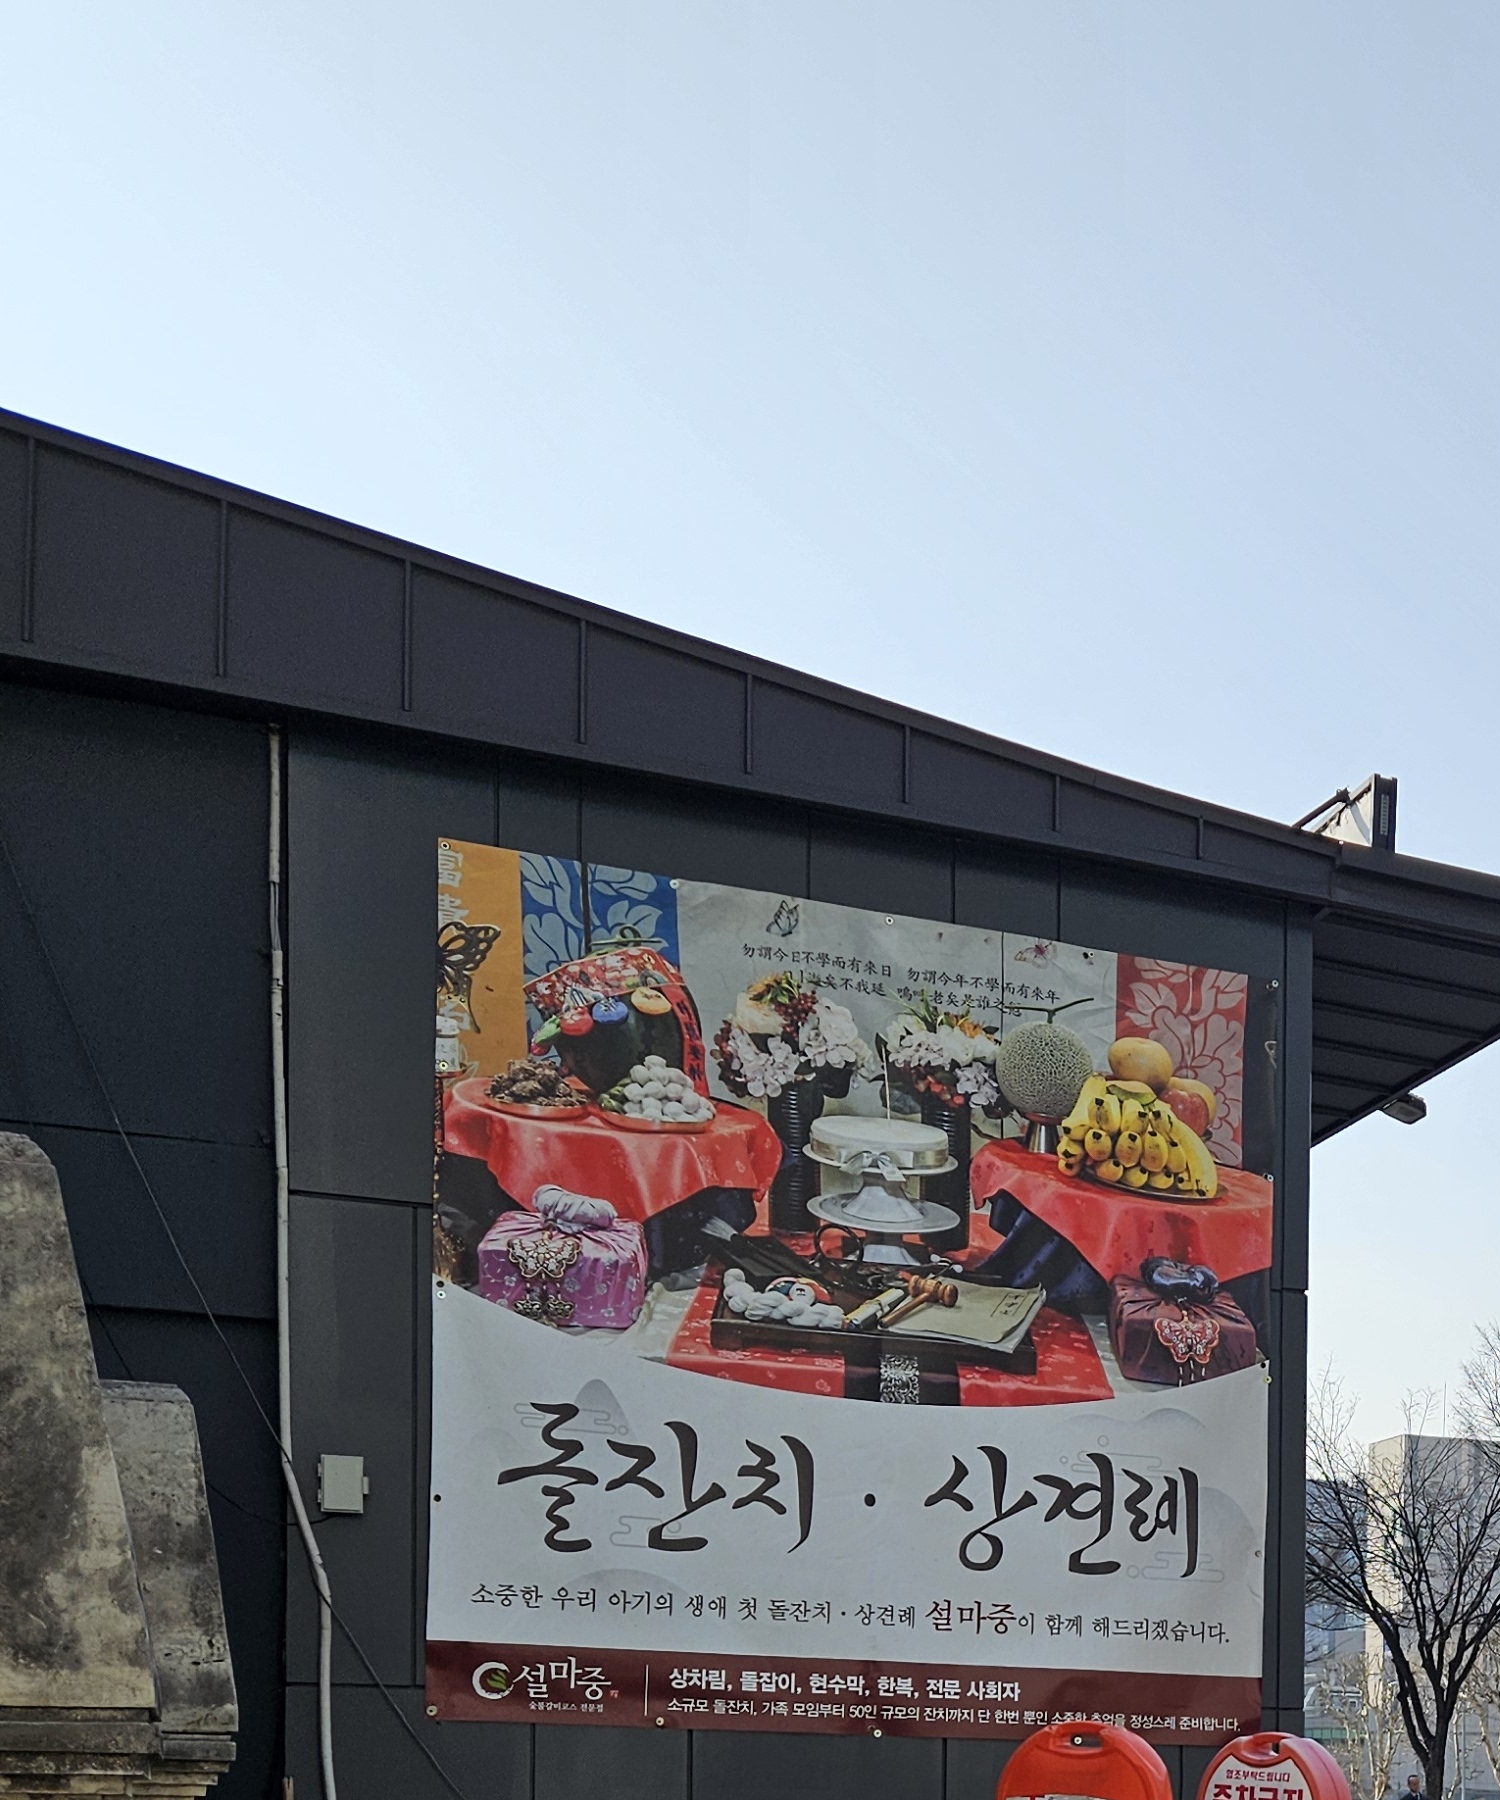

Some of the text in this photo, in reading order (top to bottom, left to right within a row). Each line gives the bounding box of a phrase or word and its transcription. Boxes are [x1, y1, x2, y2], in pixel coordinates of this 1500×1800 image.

[498, 1403, 1198, 1577] 돌잔치 상견례
[472, 1584, 1229, 1643] 소중한 우리 아기의 생애 첫 돌잔치 상견례 설마중이 함께 해드리겠습니다.
[514, 1655, 612, 1699] 설마중
[670, 1669, 1020, 1701] 상차림, 돌잡이, 현수막, 한복, 전문 사회자
[668, 1698, 709, 1712] 소규모
[713, 1700, 757, 1715] 돌잔치,
[762, 1702, 788, 1716] 가족
[792, 1703, 844, 1718] 모임부터
[849, 1705, 876, 1718] 50인
[881, 1706, 919, 1721] 규모의
[924, 1708, 973, 1722] 잔치까지
[978, 1710, 990, 1723] 단
[1130, 1714, 1175, 1730] 정성스레
[1179, 1717, 1240, 1731] 준비합니다.
